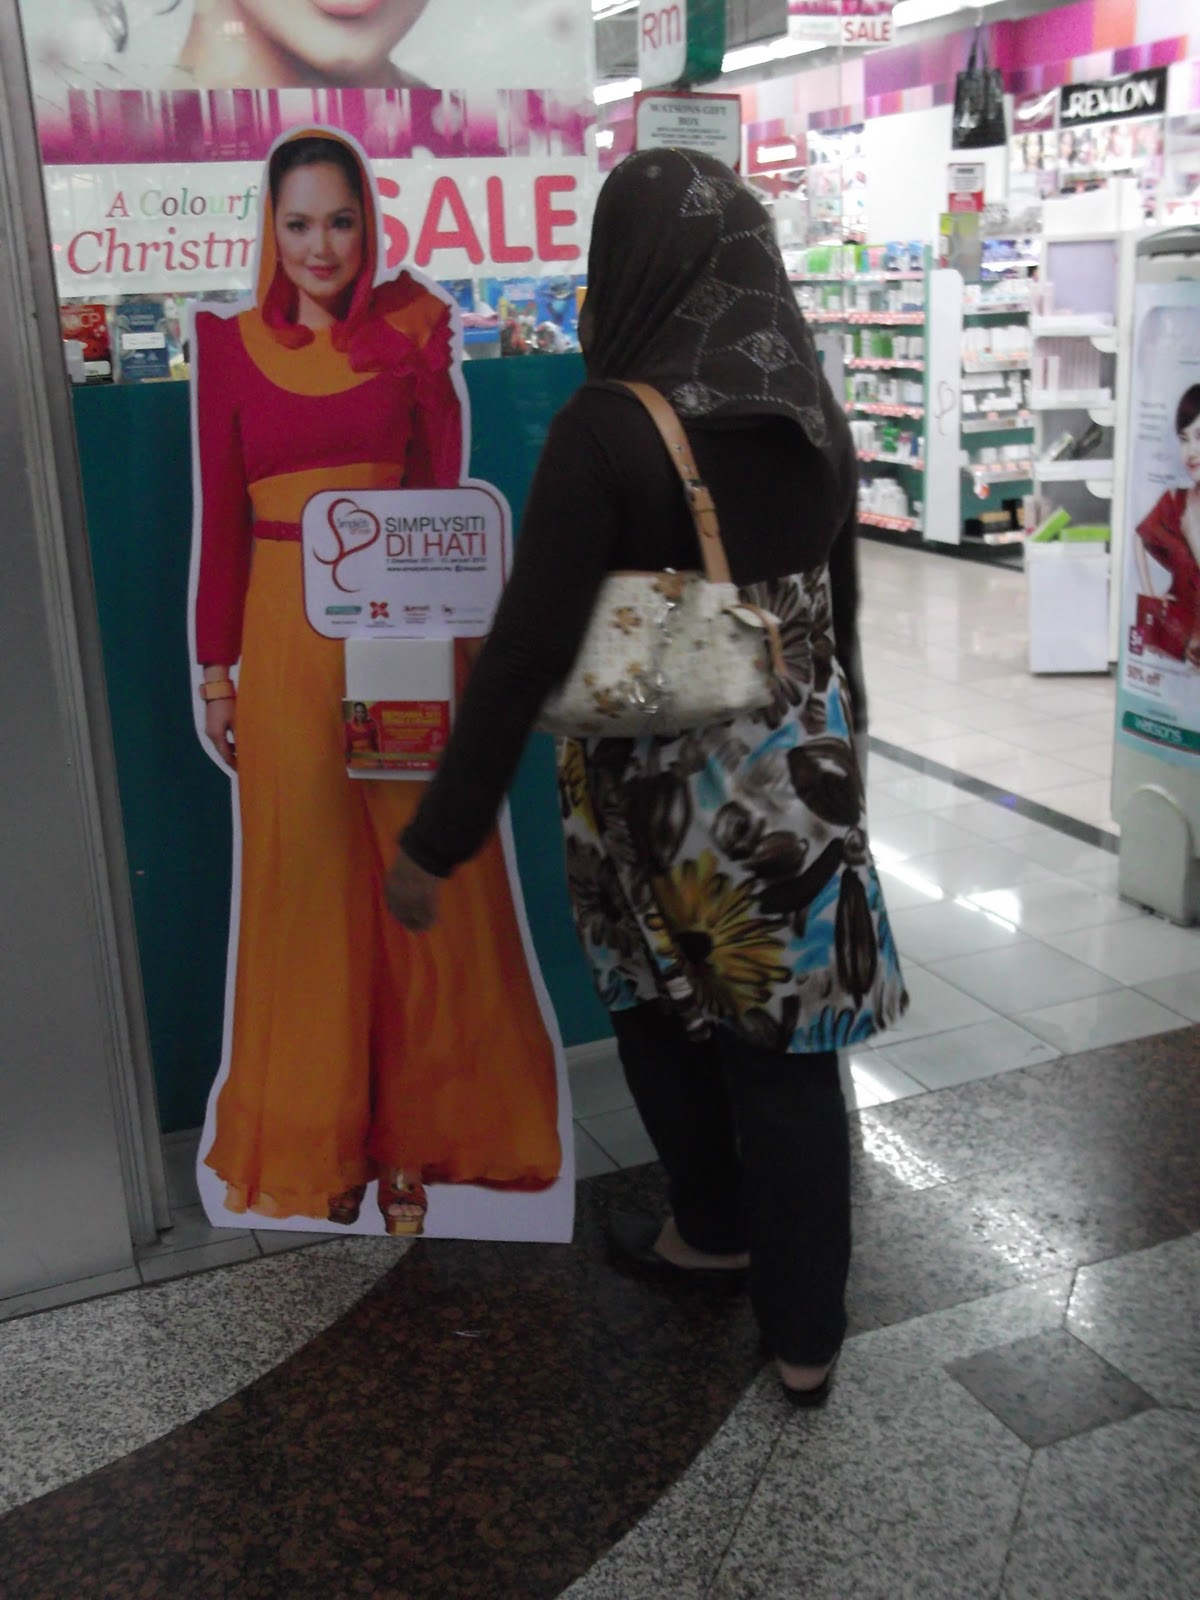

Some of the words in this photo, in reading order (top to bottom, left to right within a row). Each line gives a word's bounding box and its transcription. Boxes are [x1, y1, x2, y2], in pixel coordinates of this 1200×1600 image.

[642, 4, 682, 50] RM
[844, 20, 892, 42] SALE
[1061, 77, 1158, 119] REVLON
[105, 191, 130, 218] A
[139, 185, 259, 220] Colourf
[375, 174, 582, 269] SALE
[385, 516, 486, 533] SIMPLYSITI
[386, 532, 413, 557] DI
[423, 532, 487, 557] HATI
